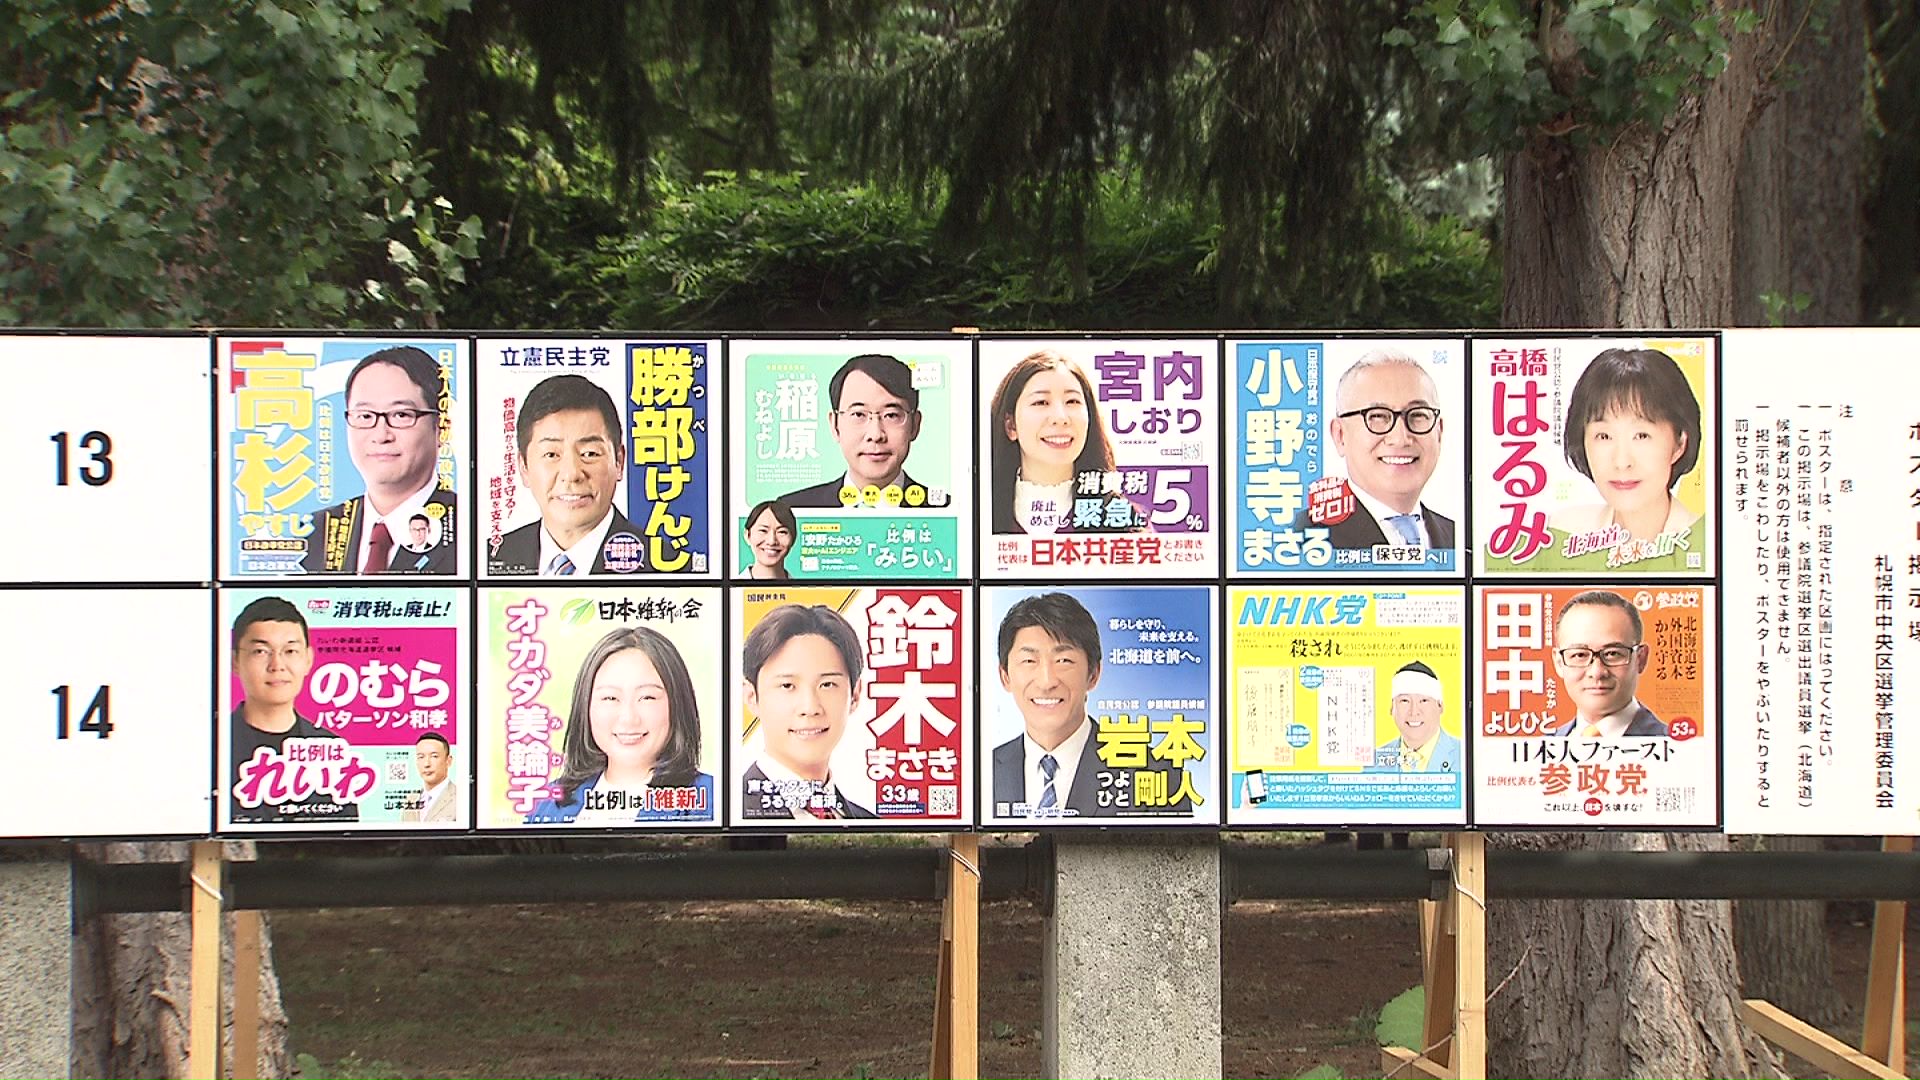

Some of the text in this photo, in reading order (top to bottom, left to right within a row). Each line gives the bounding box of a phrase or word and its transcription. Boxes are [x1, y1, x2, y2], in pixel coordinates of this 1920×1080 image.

[500, 346, 610, 366] 立憲民主党
[1489, 349, 1548, 377] 高橋
[1095, 351, 1203, 402] 宮内
[692, 355, 705, 432] かつべ
[233, 348, 317, 512] 高杉
[755, 389, 774, 460] むねよし
[776, 378, 819, 459] 稲原
[1112, 407, 1203, 434] しおり
[1244, 349, 1305, 525] 小野寺
[1305, 413, 1318, 473] おのでら
[50, 430, 113, 486] 13
[631, 347, 695, 572] 勝部けんじ
[1489, 380, 1552, 560] はるみ
[1735, 419, 1749, 521] 罰せられます。
[1078, 470, 1149, 495] 消費税
[1031, 500, 1057, 512] 廃止
[1073, 498, 1148, 528] 緊急に
[1151, 469, 1203, 530] 5%
[239, 513, 315, 536] やすじ
[886, 528, 932, 544] 比例は
[1030, 514, 1070, 528] めざし
[998, 541, 1018, 552] 比例
[1031, 537, 1161, 566] 日本共産党
[1164, 540, 1203, 550] とお書き
[1243, 528, 1332, 566] まさる
[1336, 550, 1372, 565] 比例は
[1376, 547, 1422, 562] 保守党
[1776, 418, 1791, 663] 候補者以外の方は使用できません。
[867, 543, 952, 573] 「みらい」
[998, 555, 1027, 565] 代表は
[1164, 552, 1204, 563] ください
[333, 600, 451, 618] 消費税は廃止!
[598, 596, 703, 624] 日本維新の会
[1239, 594, 1367, 625] NHK党
[1656, 592, 1699, 609] 参政党
[1818, 429, 1833, 766] ポスターは、指定された区画にはってください。
[1109, 648, 1201, 664] 北海道を前へ。
[1291, 639, 1343, 658] 殺され
[1486, 593, 1544, 710] 田中
[1655, 620, 1668, 680] から守る
[1670, 617, 1683, 680] 外国資本
[1684, 616, 1697, 680] 北海道を
[310, 659, 450, 708] のむら
[867, 594, 958, 745] 鈴木
[1874, 554, 1893, 808] 札幌市中央区選挙管理委員会
[507, 600, 550, 813] オカダ美輪子
[1546, 678, 1557, 709] たなか
[51, 684, 114, 740] 14
[314, 712, 449, 729] パターソン和孝
[1485, 711, 1557, 734] よしひと
[289, 743, 345, 762] 比例は
[1096, 714, 1205, 768] 岩本
[1512, 740, 1676, 763] 日本人ファースト
[240, 752, 377, 802] れいわ
[866, 747, 957, 782] まさき
[1096, 770, 1130, 788] つよ
[1134, 770, 1205, 807] 剛人
[1487, 776, 1536, 786] 比例代表も
[384, 800, 425, 810] 山本太郎
[1097, 790, 1130, 807] ひと
